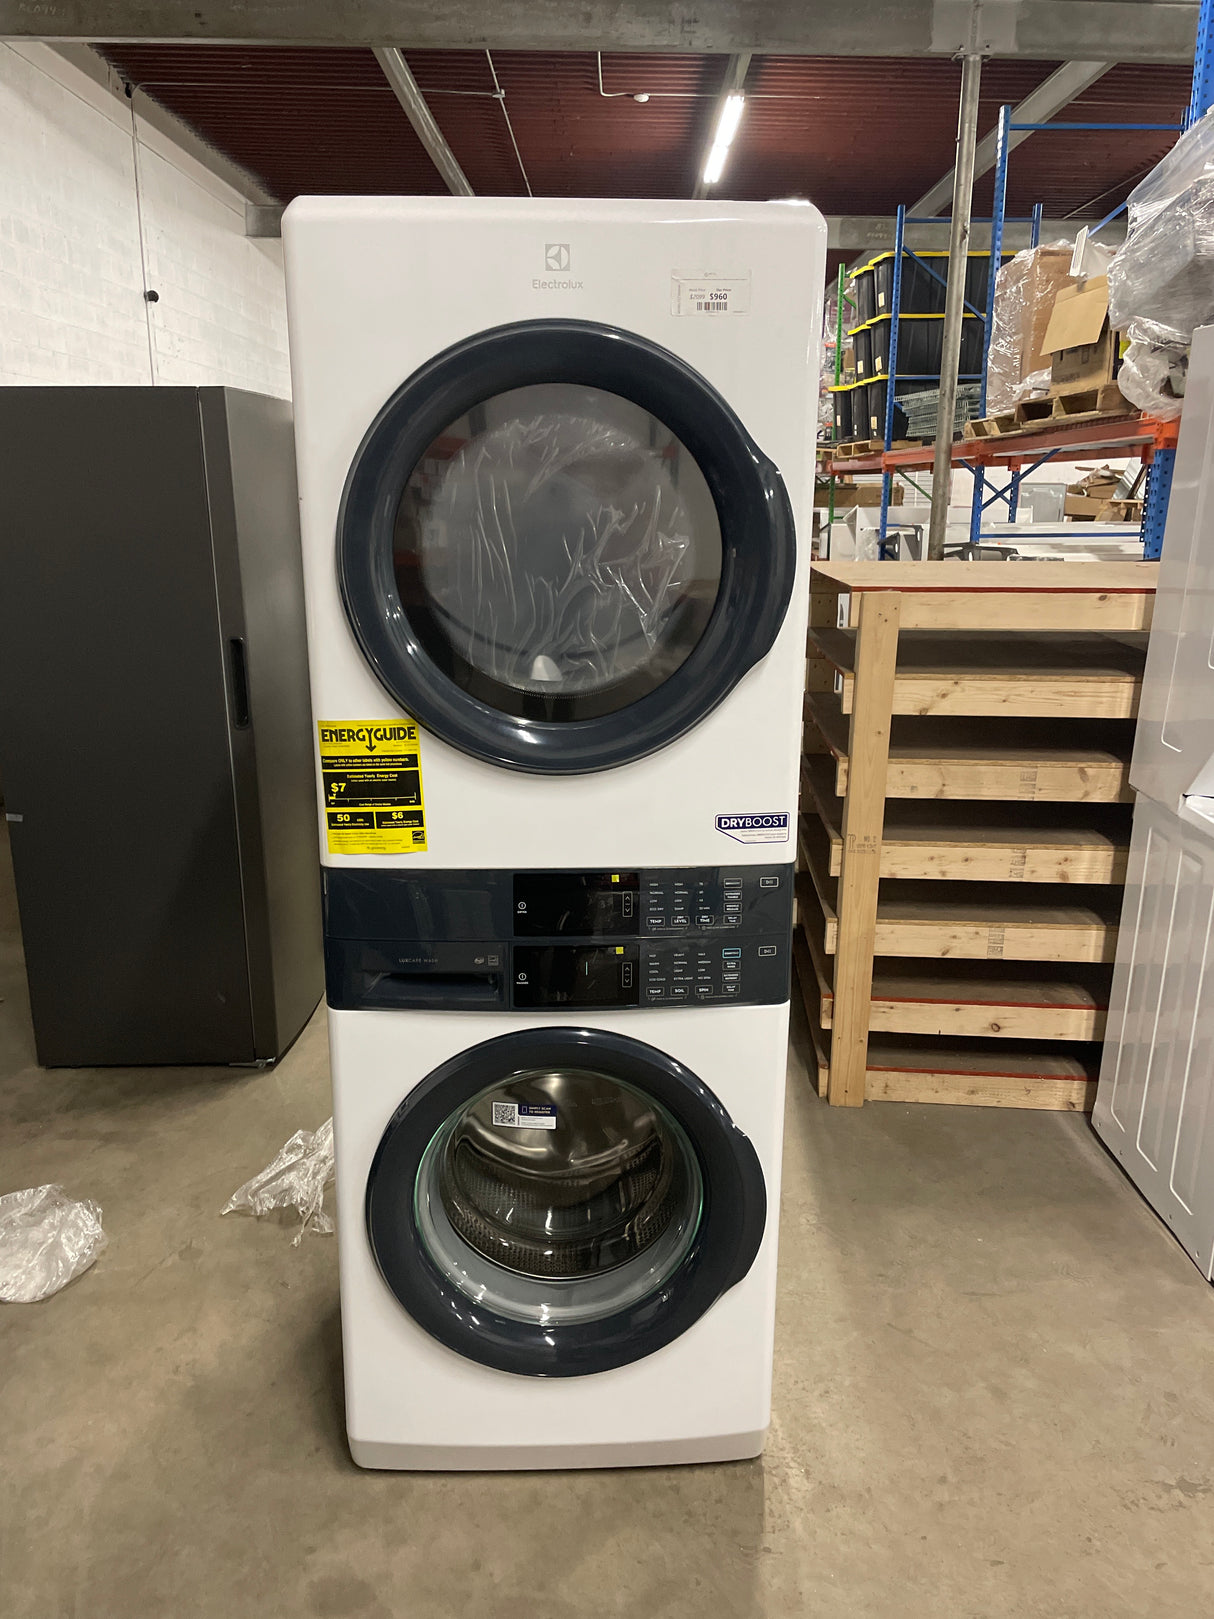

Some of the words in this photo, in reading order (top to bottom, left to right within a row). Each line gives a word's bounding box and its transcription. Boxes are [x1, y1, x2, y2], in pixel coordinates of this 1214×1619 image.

[532, 279, 583, 289] Electrolux
[709, 292, 728, 300] $960
[320, 726, 416, 743] ENERGYGUIDE
[330, 782, 347, 793] $7
[336, 814, 350, 822] 50
[391, 811, 404, 820] $6
[721, 816, 786, 828] DRYBOOST
